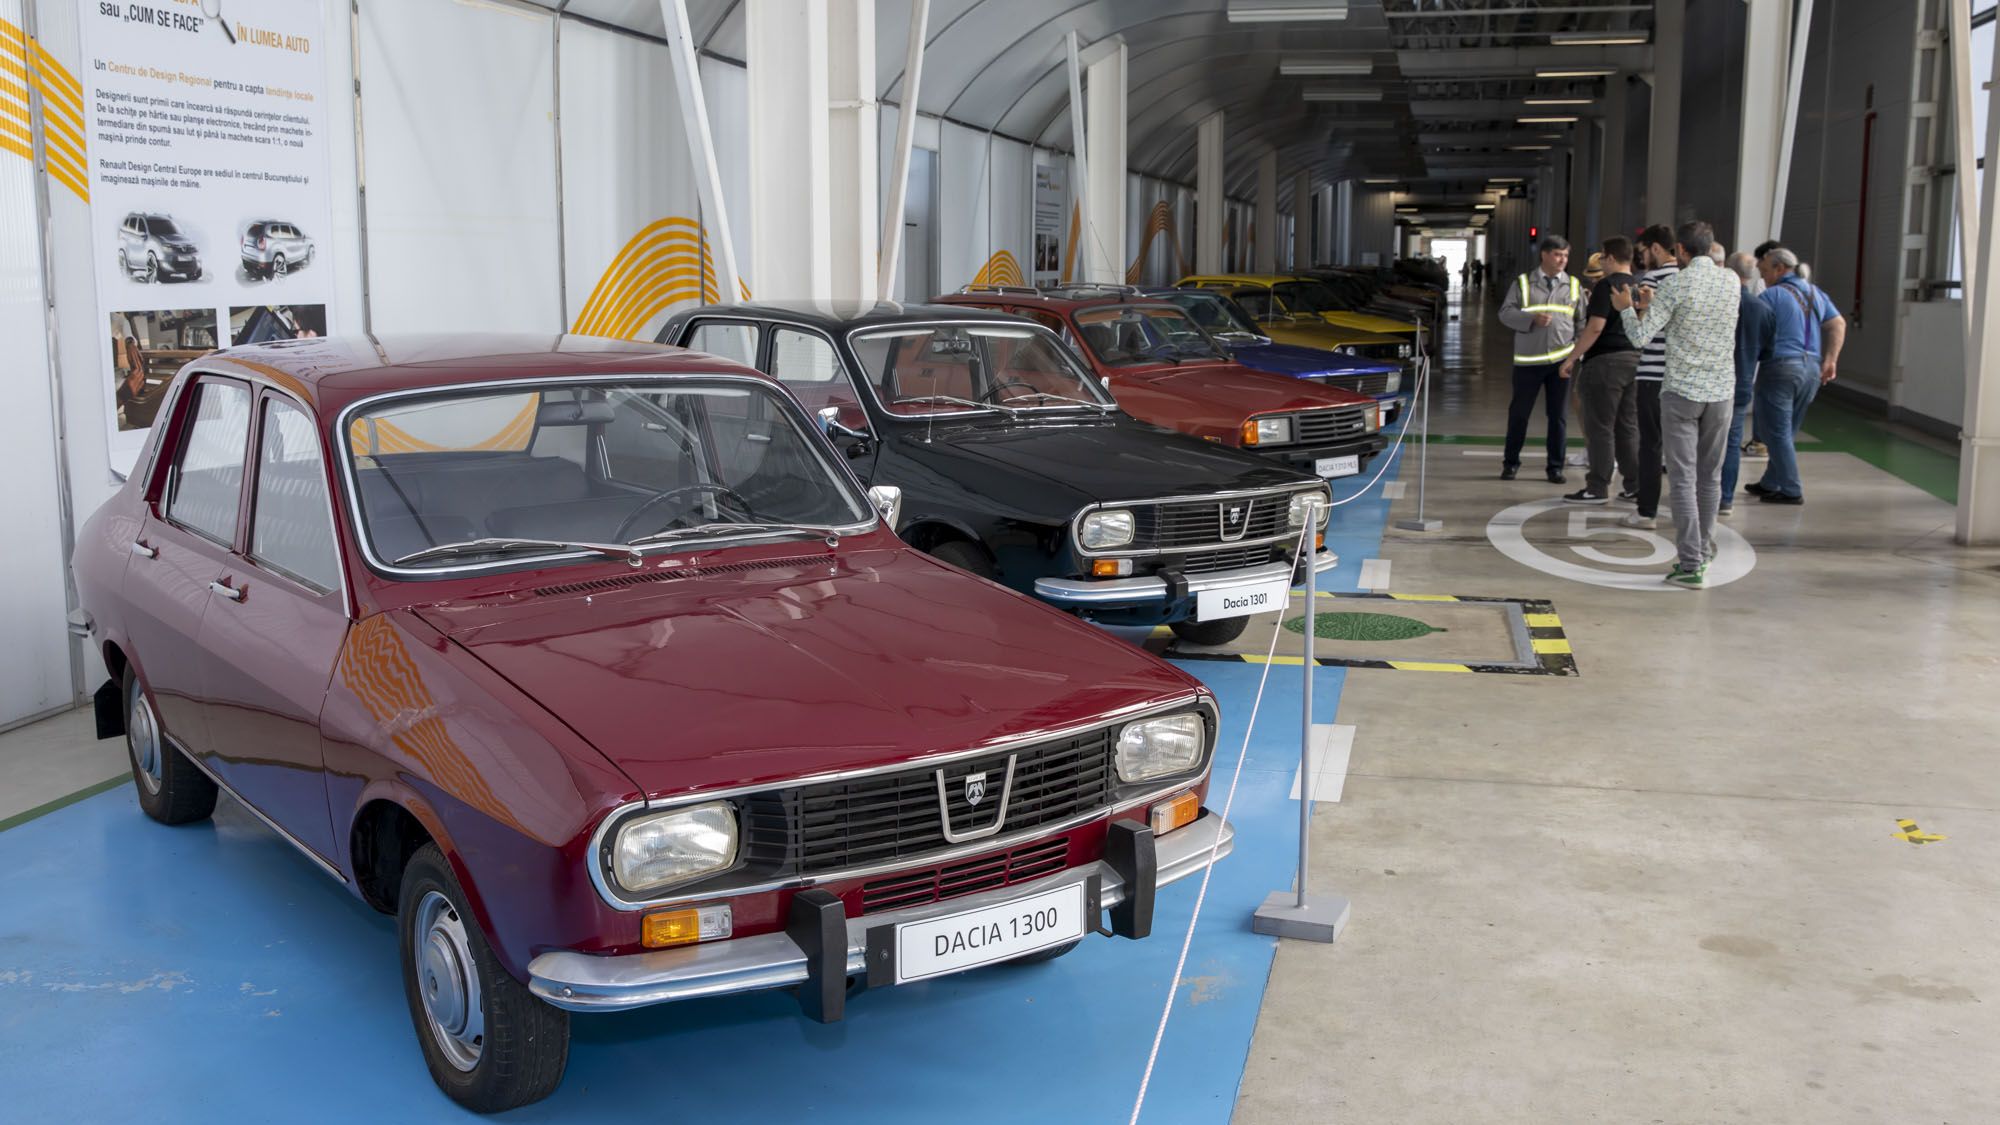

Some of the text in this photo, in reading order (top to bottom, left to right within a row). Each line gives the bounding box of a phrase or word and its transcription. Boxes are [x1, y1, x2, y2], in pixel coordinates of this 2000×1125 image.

[100, 2, 120, 17] sau
[124, 4, 154, 24] „CUM
[157, 10, 170, 27] SE
[250, 27, 283, 48] LUMEA
[285, 35, 310, 54] AUTO
[94, 59, 106, 70] Un
[108, 61, 136, 75] Centru
[138, 66, 148, 77] de
[150, 68, 177, 82] Design
[179, 72, 212, 87] Regional
[213, 79, 237, 90] pentru
[245, 84, 264, 96] capta
[96, 89, 132, 102] Designerii
[133, 95, 148, 104] sunt
[150, 97, 169, 107] primii
[171, 101, 184, 109] care
[97, 103, 106, 113] De
[108, 105, 114, 114] la
[139, 110, 147, 118] pe
[267, 124, 278, 133] prin
[280, 126, 304, 135] machete
[97, 118, 134, 130] termediare
[137, 122, 147, 131] din
[221, 131, 226, 139] la
[228, 133, 253, 142] machete
[125, 135, 147, 145] prinde
[100, 159, 126, 170] Renault
[128, 161, 152, 174] Design
[153, 164, 177, 174] Central
[179, 166, 202, 176] Europe
[215, 170, 233, 178] sediul
[242, 172, 263, 180] centrul
[170, 179, 178, 187] de
[1318, 464, 1334, 472] DACIA
[1568, 512, 1678, 566] 5
[1224, 593, 1267, 609] Dacia 1301
[935, 907, 1058, 956] DACIA 1300
